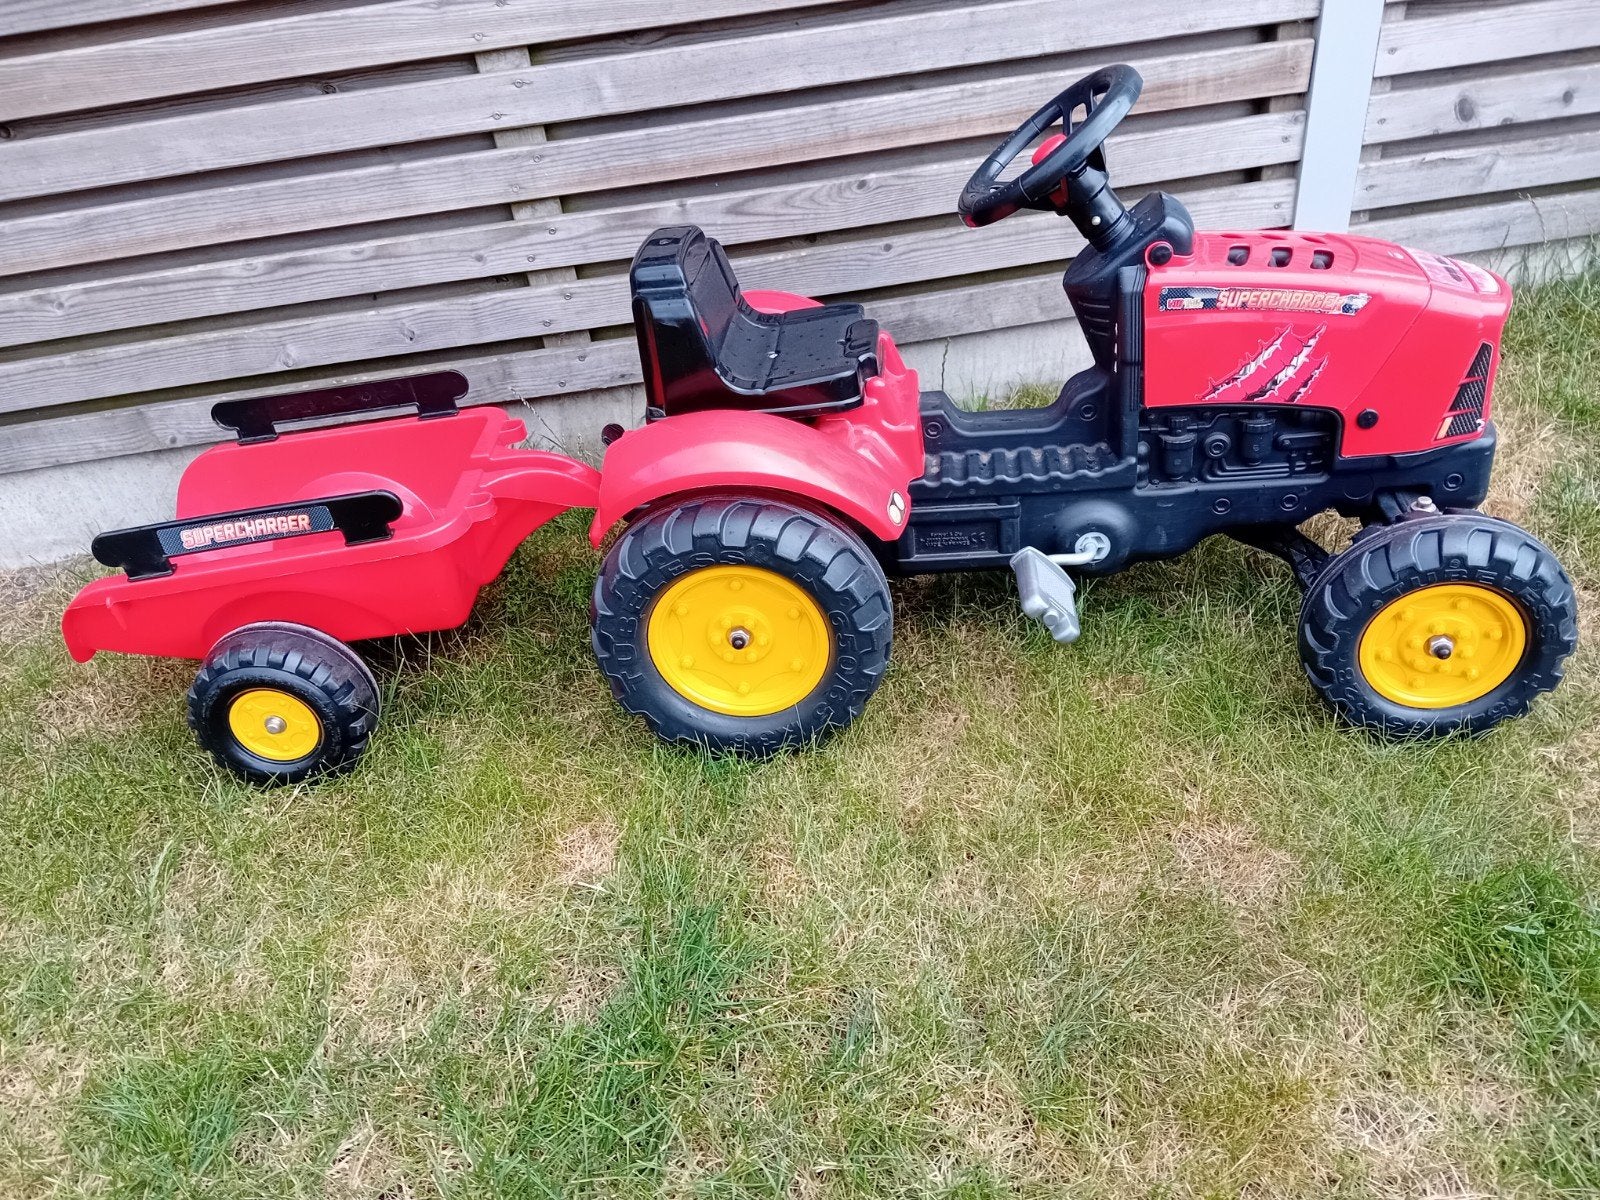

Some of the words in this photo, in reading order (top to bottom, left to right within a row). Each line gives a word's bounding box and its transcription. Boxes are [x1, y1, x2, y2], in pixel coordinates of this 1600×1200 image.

[1217, 291, 1344, 312] SUPERCHARGER
[181, 514, 311, 549] SUPERCHARGER
[614, 549, 746, 694] TUBELESS
[1381, 568, 1558, 640] TUBELESS
